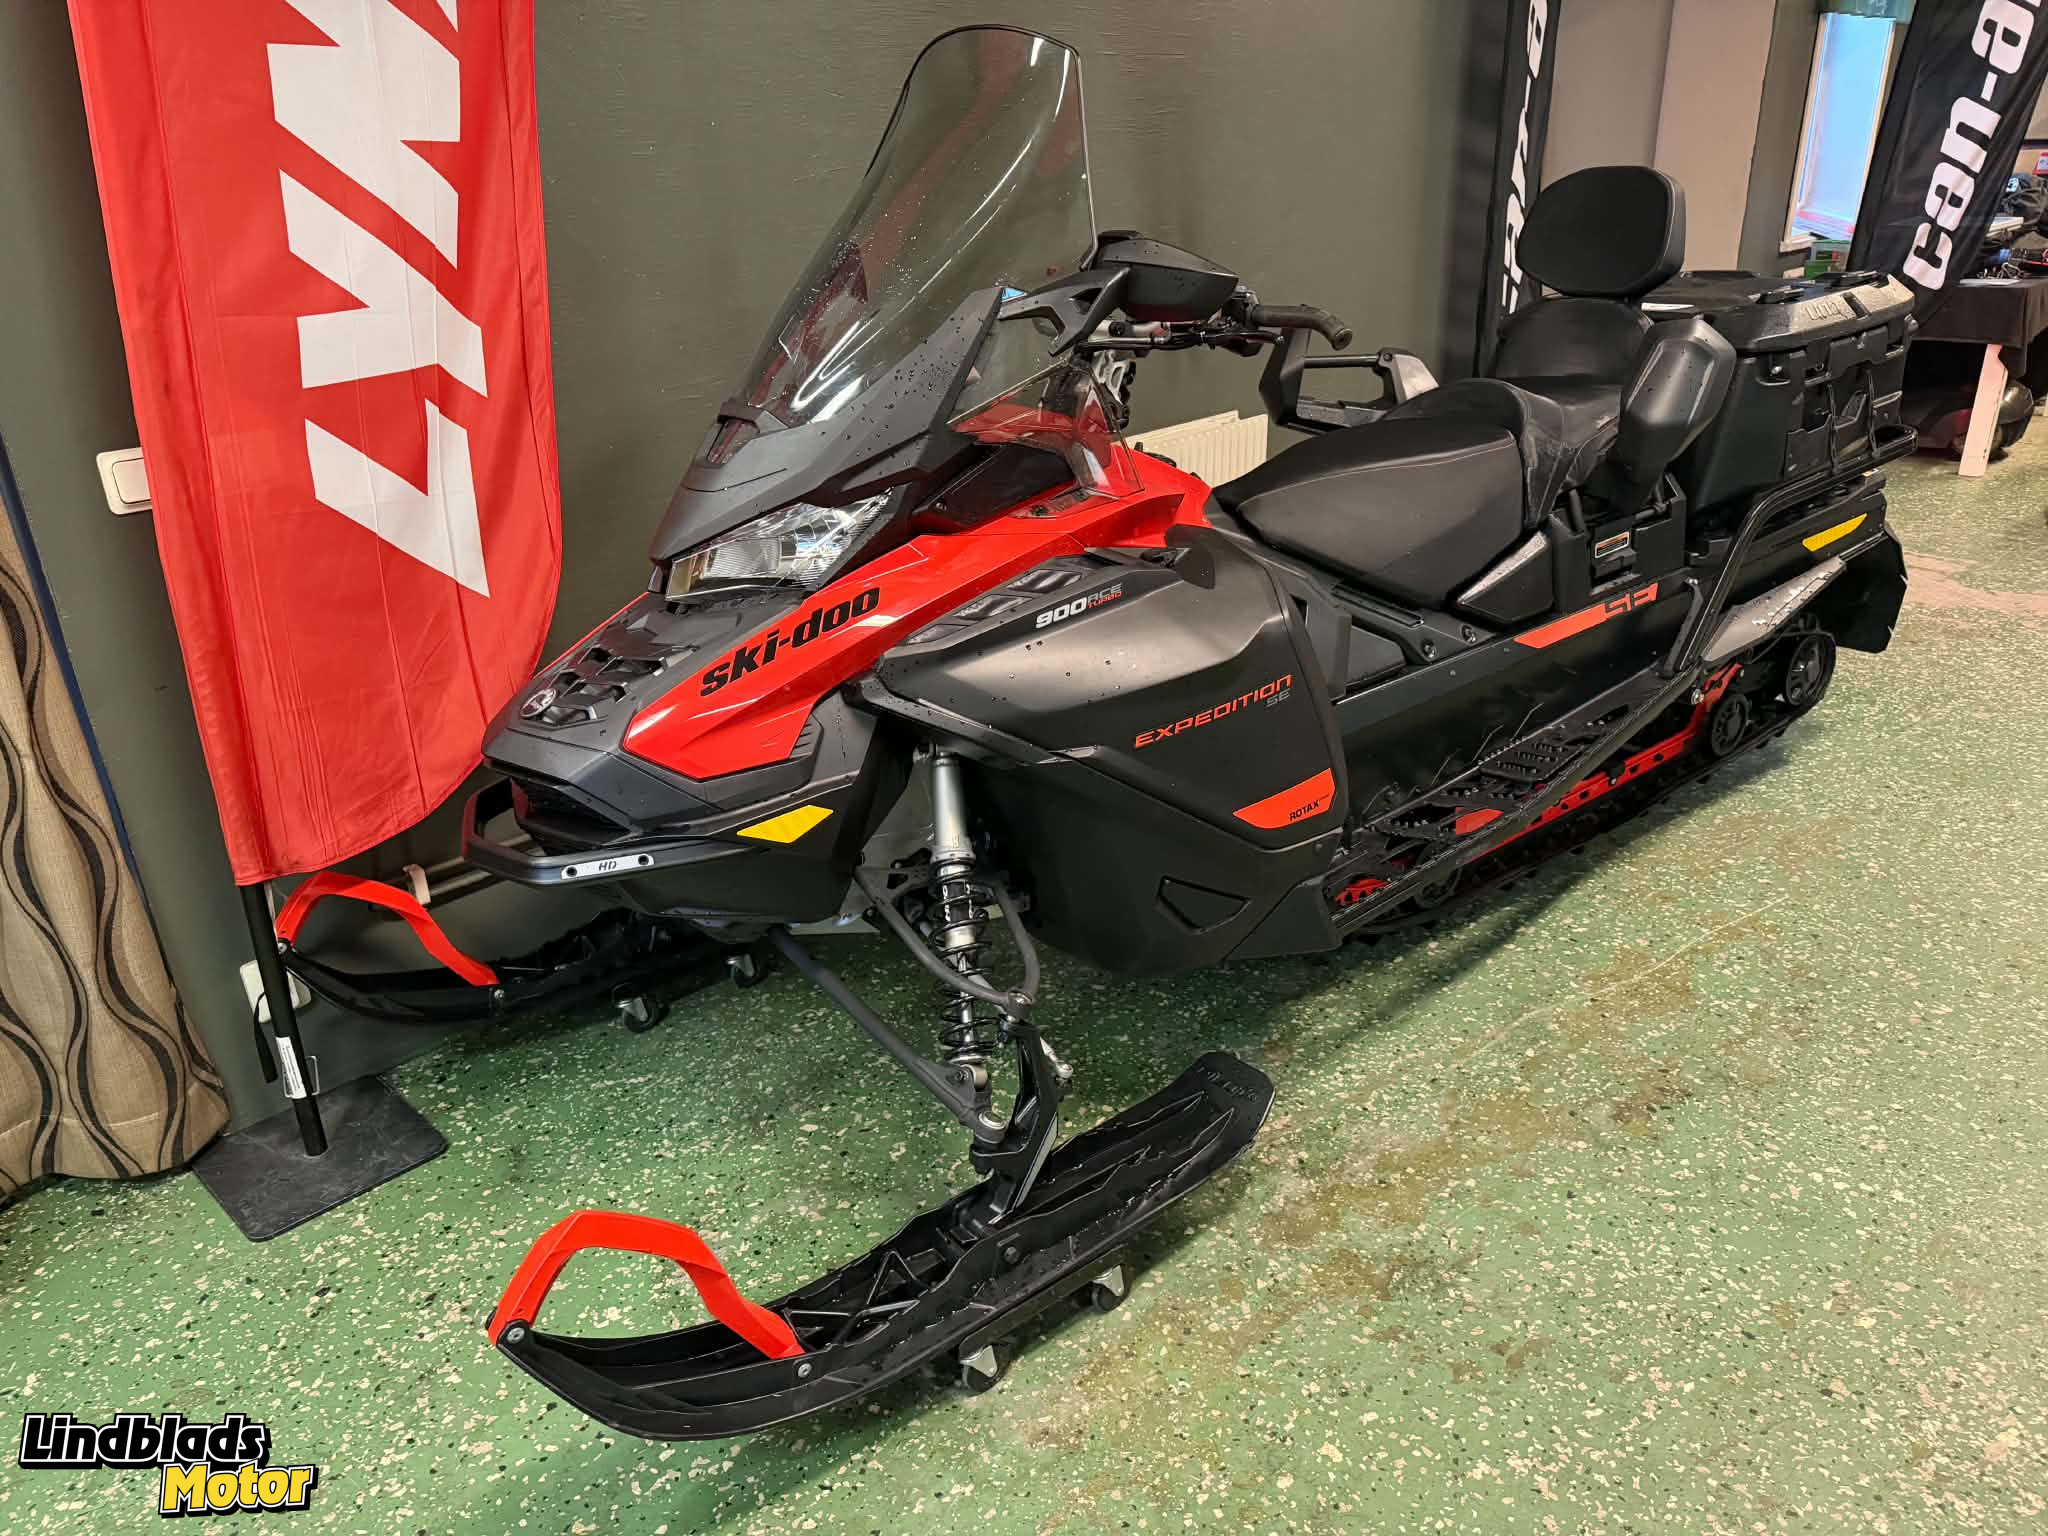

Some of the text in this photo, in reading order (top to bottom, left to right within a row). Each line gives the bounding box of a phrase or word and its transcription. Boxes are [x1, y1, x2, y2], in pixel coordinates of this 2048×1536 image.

[1903, 0, 2041, 290] can-a
[265, 0, 490, 598] LYN
[1036, 583, 1122, 628] 900 ACE
[1088, 592, 1122, 609] TURBO
[1266, 688, 1291, 708] SE
[1289, 800, 1319, 821] ROTAX
[599, 861, 617, 871] HD
